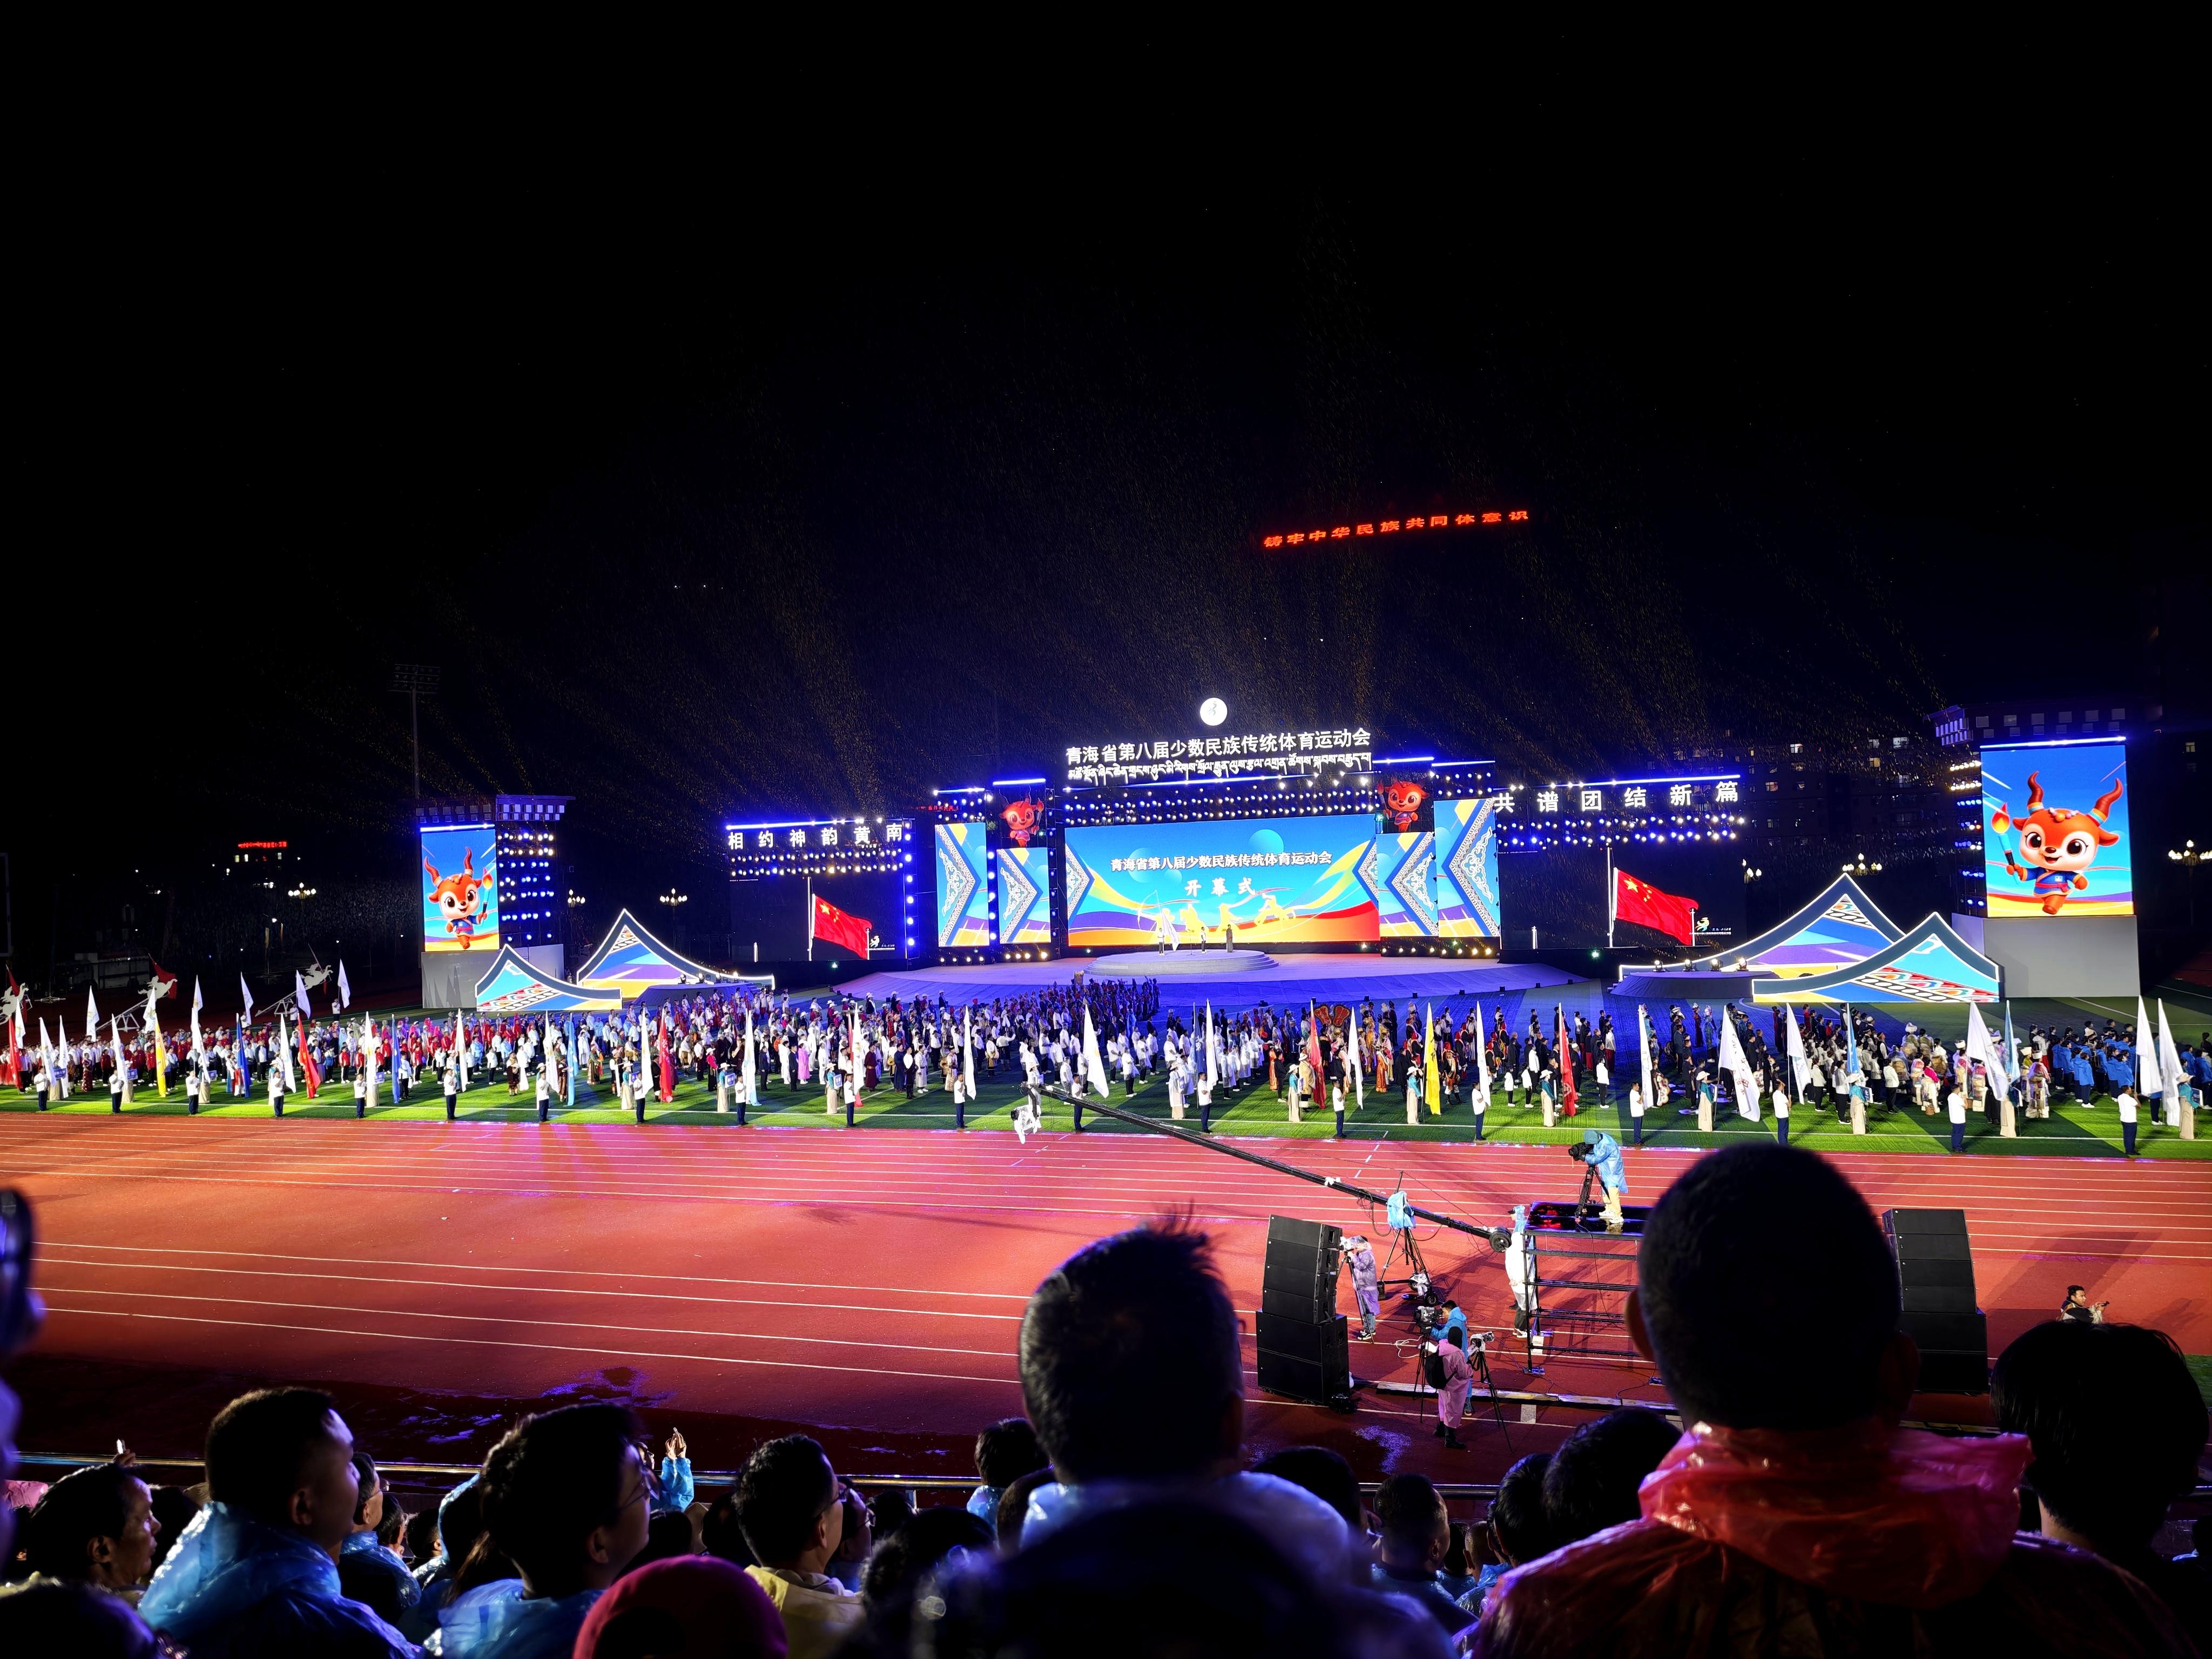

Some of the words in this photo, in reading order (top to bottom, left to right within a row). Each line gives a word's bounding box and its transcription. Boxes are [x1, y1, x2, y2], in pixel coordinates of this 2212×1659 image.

[1264, 511, 1528, 548] 铸牢中华民族共同体意识
[1066, 727, 1371, 765] 青海省第八届少数民族传统体育运动会
[1494, 781, 1738, 813] 共谱团结新篇
[728, 824, 902, 849] 相约神韵黄南
[1110, 851, 1332, 872] 青海省第八届少数民族传统体育运动会
[1184, 878, 1256, 897] 开幕式
